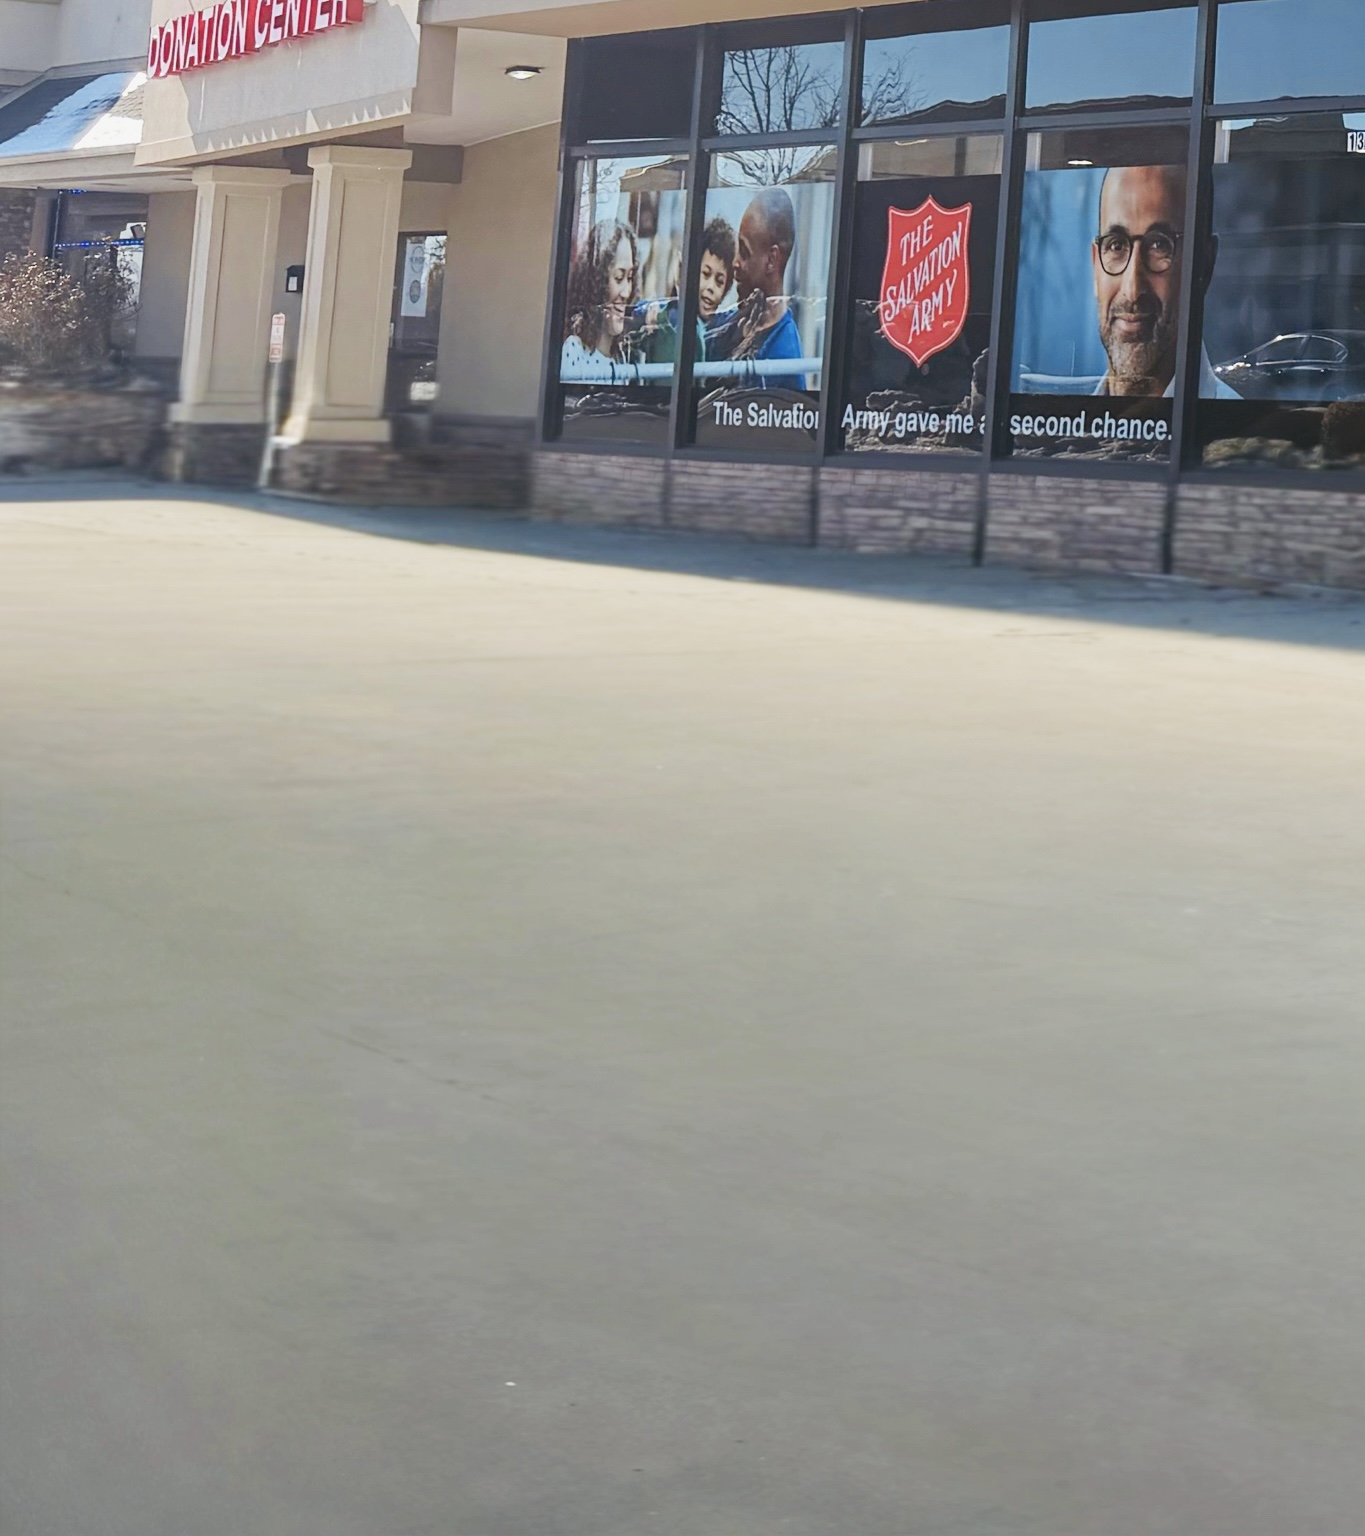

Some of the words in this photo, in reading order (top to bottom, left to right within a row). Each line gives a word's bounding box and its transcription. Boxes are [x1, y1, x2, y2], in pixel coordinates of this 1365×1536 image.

[884, 221, 963, 322] SALVATION
[900, 215, 934, 266] THE
[906, 268, 958, 345] ARMY
[713, 401, 742, 426] The
[841, 404, 890, 437] Army
[895, 412, 939, 438] gave
[945, 413, 974, 434] me
[1010, 410, 1086, 437] second
[1091, 411, 1173, 441] chance.
